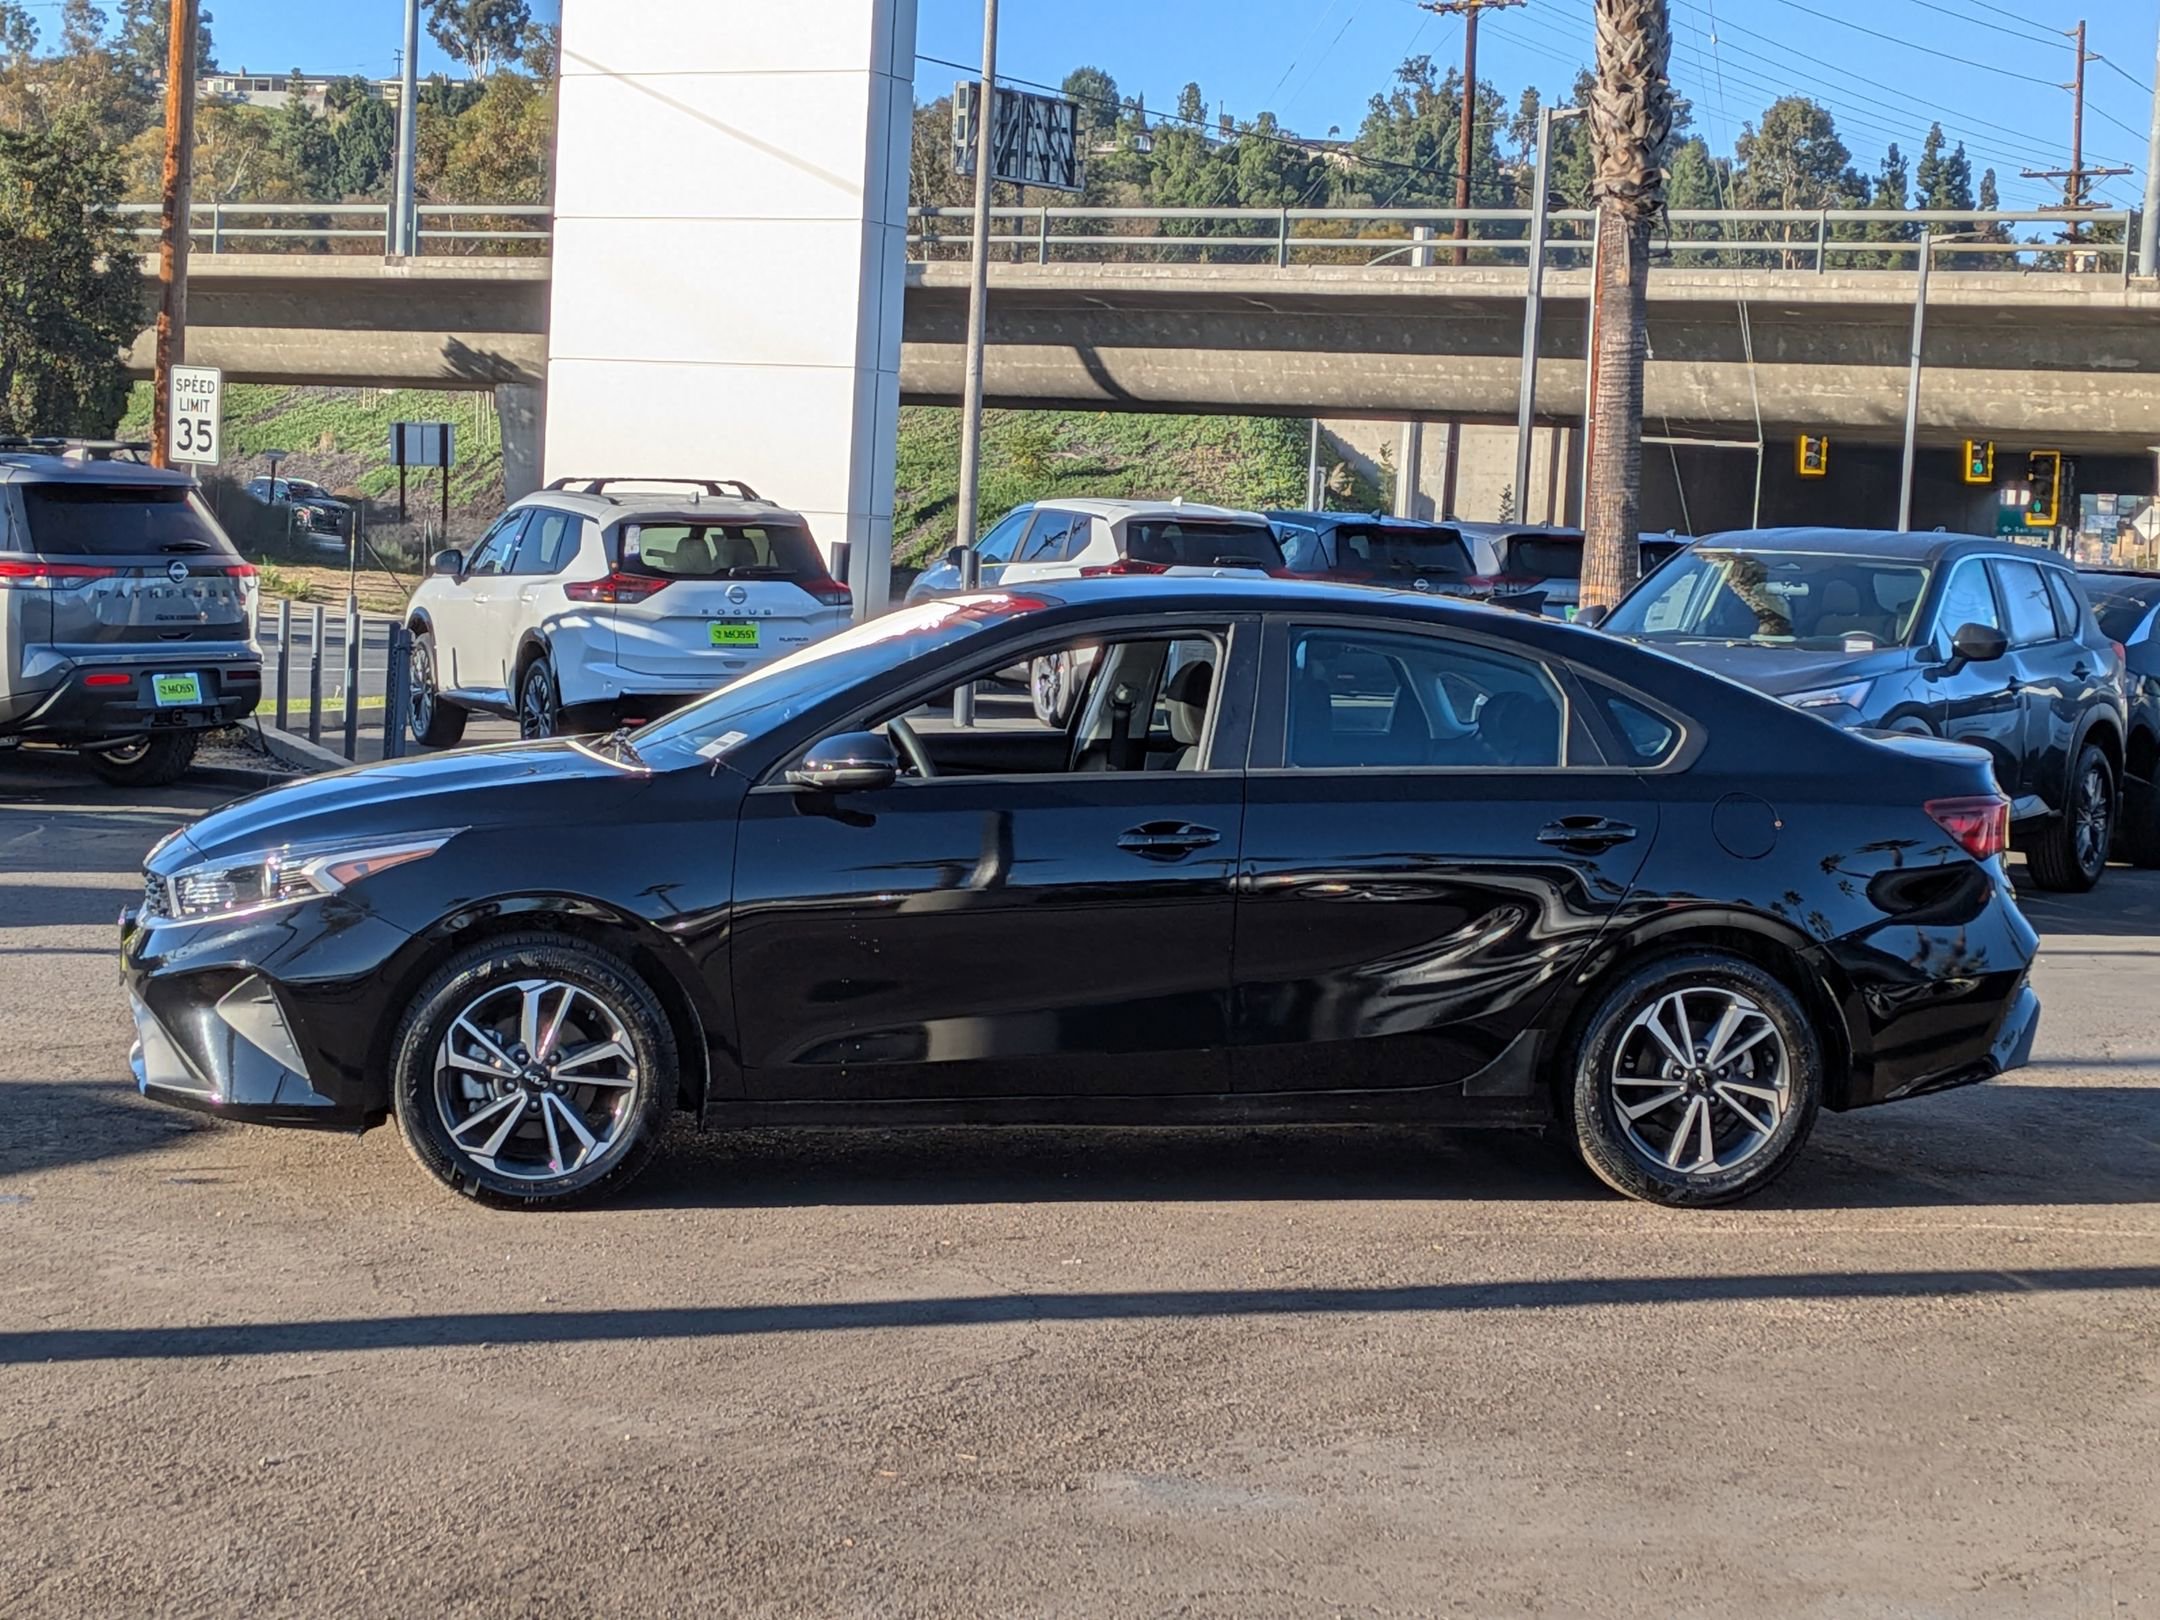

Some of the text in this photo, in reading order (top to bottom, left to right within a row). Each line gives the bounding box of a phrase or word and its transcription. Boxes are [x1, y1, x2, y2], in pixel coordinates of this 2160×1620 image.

[176, 378, 215, 394] SPEED
[179, 398, 210, 413] LIMIT
[176, 417, 213, 452] 35
[701, 608, 772, 616] ROGUE
[723, 630, 757, 640] MOSSY
